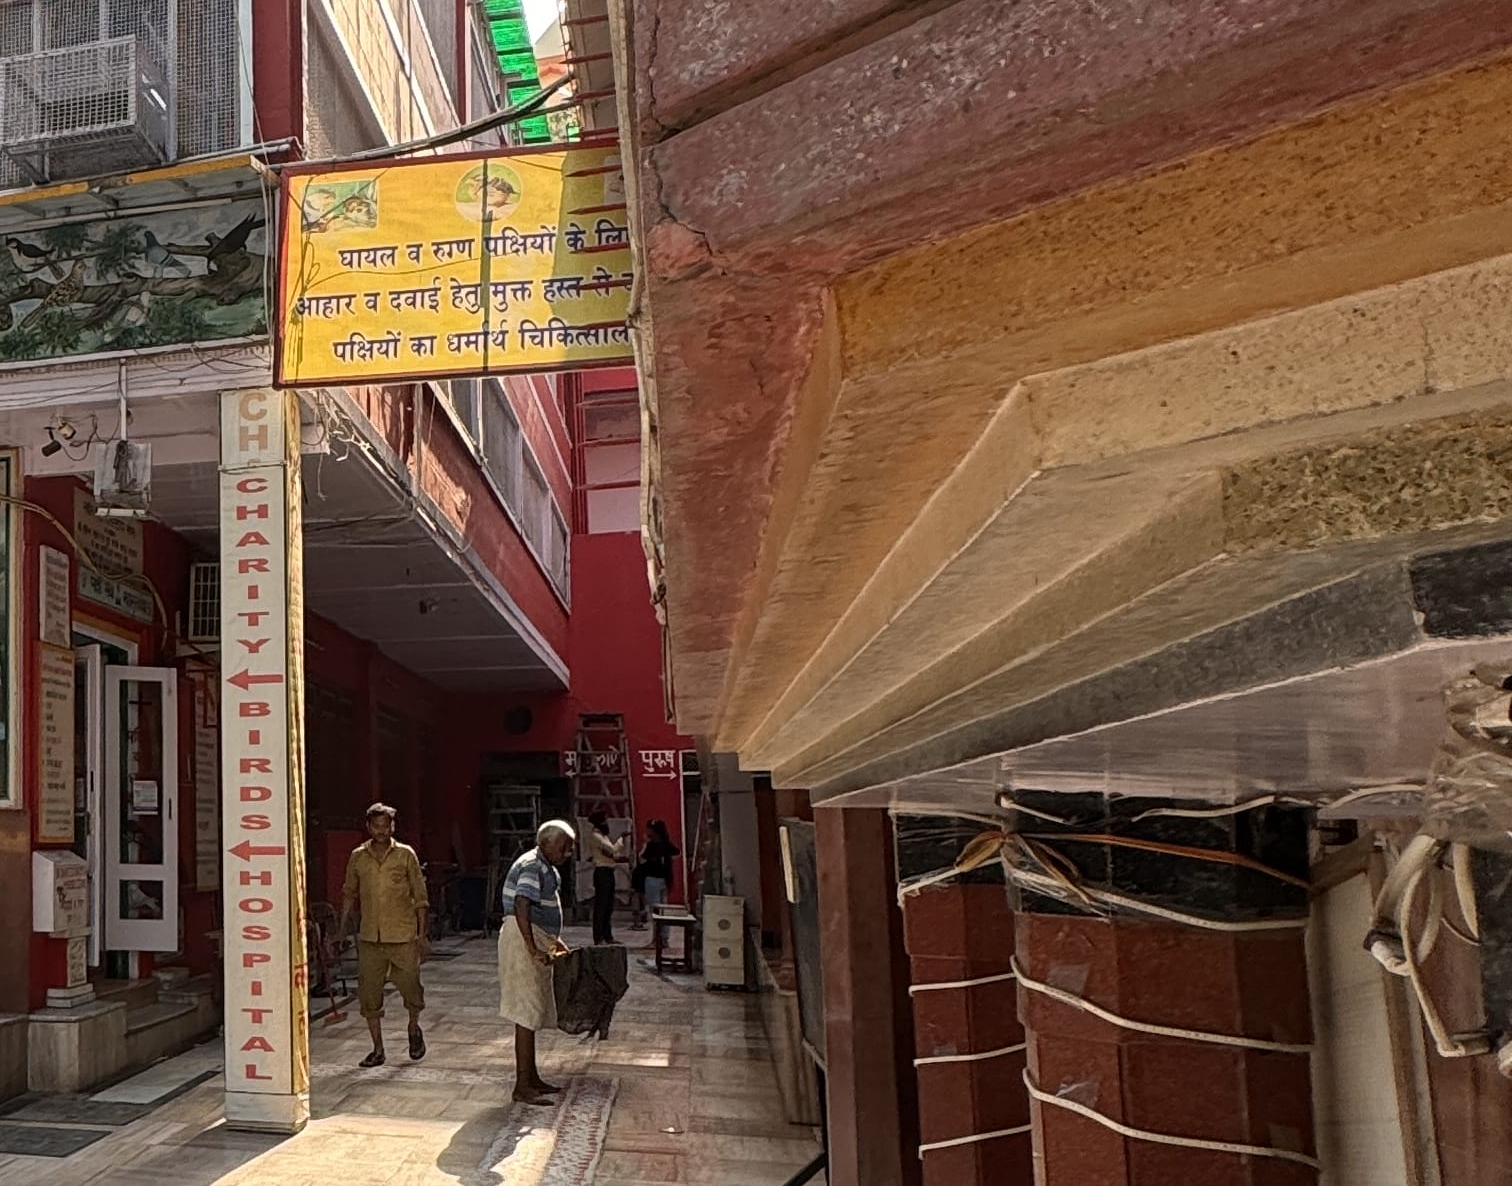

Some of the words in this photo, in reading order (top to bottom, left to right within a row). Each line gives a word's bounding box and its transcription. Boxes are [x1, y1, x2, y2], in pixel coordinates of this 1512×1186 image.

[338, 245, 398, 269] घायल
[406, 243, 423, 264] व
[484, 225, 556, 258] पक्षियों
[565, 222, 586, 251] के
[595, 218, 629, 247] लि
[295, 292, 356, 318] आहार
[365, 292, 380, 313] व
[389, 277, 441, 314] दवाई
[450, 277, 482, 315] हेतु
[489, 281, 533, 313] मुक्त
[543, 275, 584, 303] हस्त
[592, 267, 612, 297] से
[333, 330, 402, 363] पक्षियों
[409, 335, 437, 359] का
[447, 319, 510, 356] धर्मार्थ
[519, 317, 629, 350] चिकित्साल
[239, 392, 268, 463] CH
[236, 478, 270, 654] CHARITY
[239, 702, 273, 831] BIRDS
[239, 871, 275, 1081] HOSPITAL
